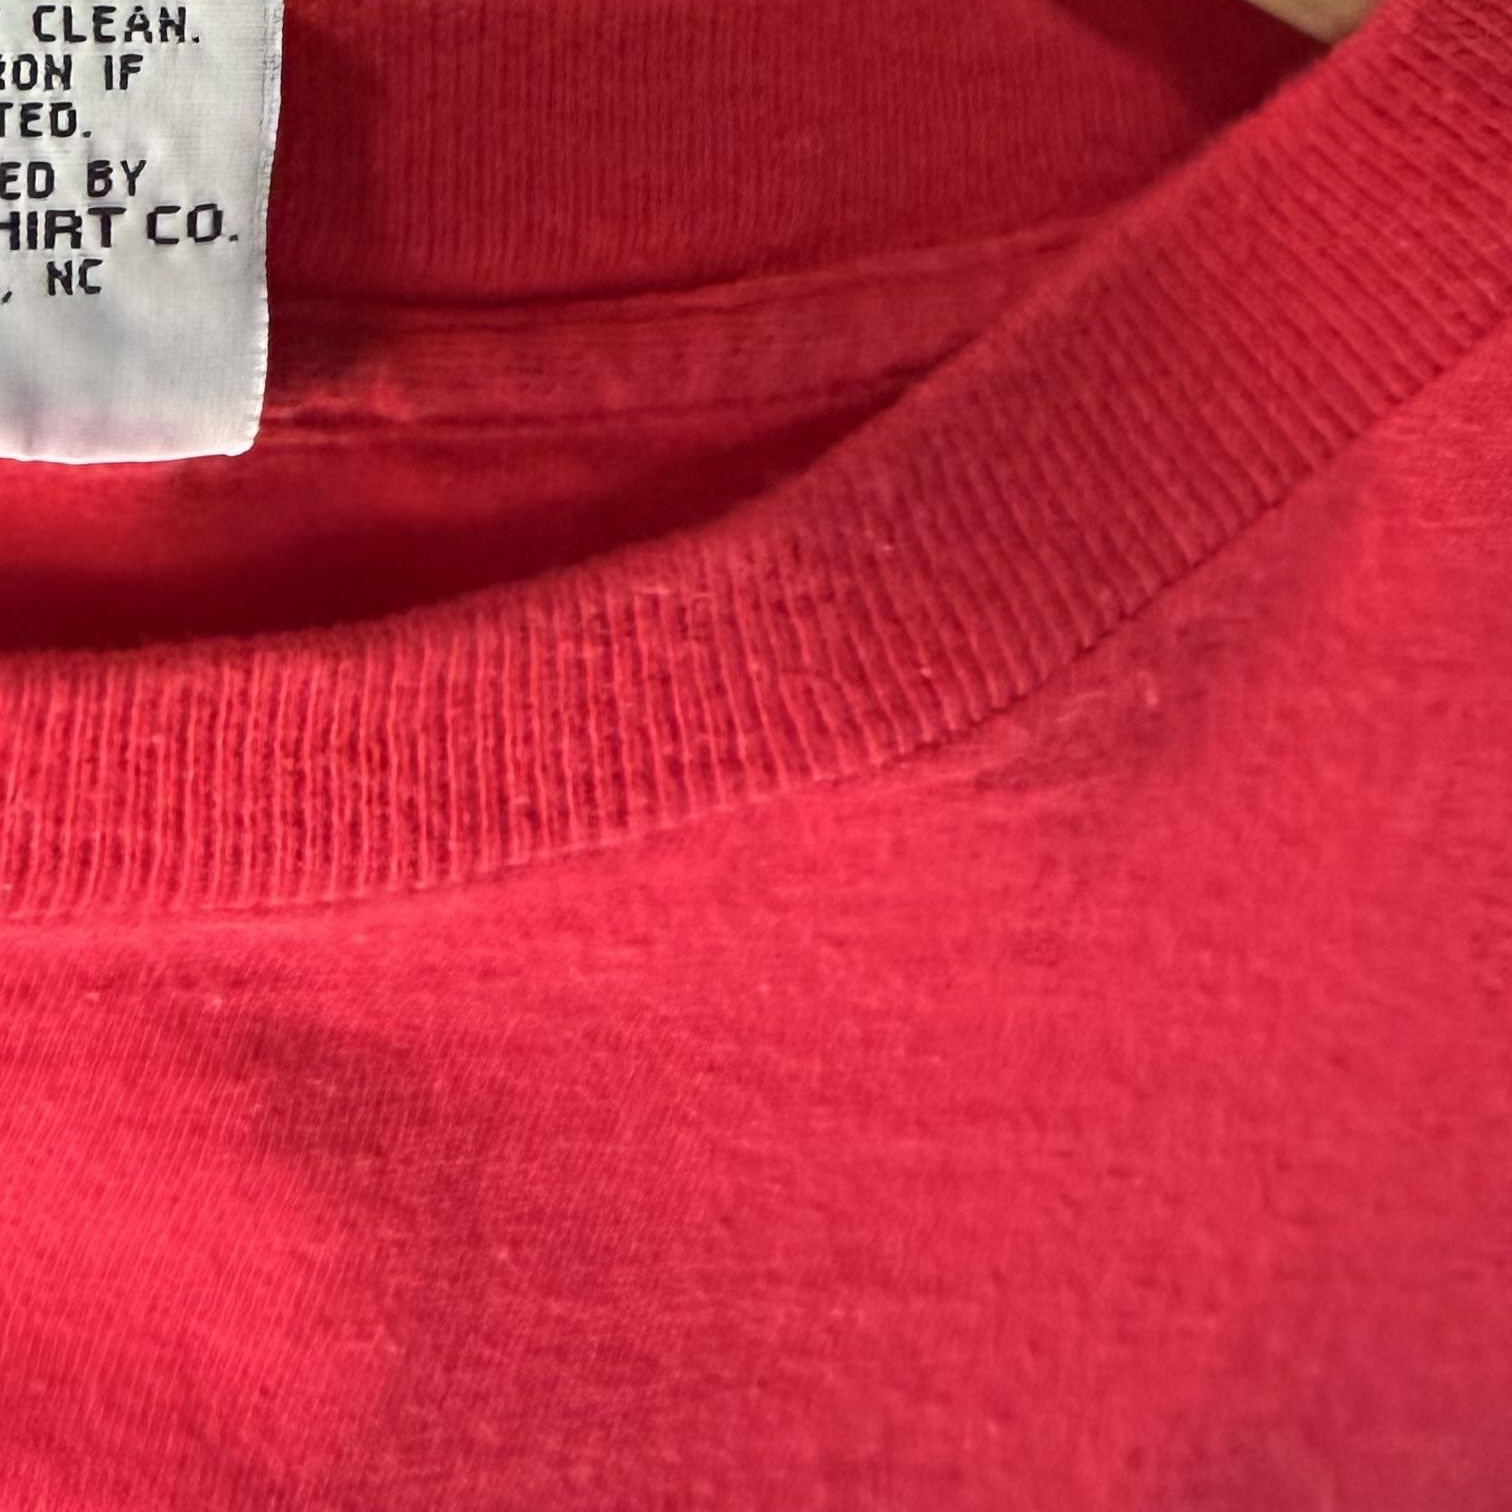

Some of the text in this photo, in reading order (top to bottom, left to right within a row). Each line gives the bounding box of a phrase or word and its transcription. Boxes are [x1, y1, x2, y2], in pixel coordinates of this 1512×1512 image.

[32, 4, 200, 44] CLEAN.
[104, 53, 144, 91] IF
[86, 159, 147, 199] BY
[145, 202, 239, 246] CO.
[46, 258, 103, 297] NC
